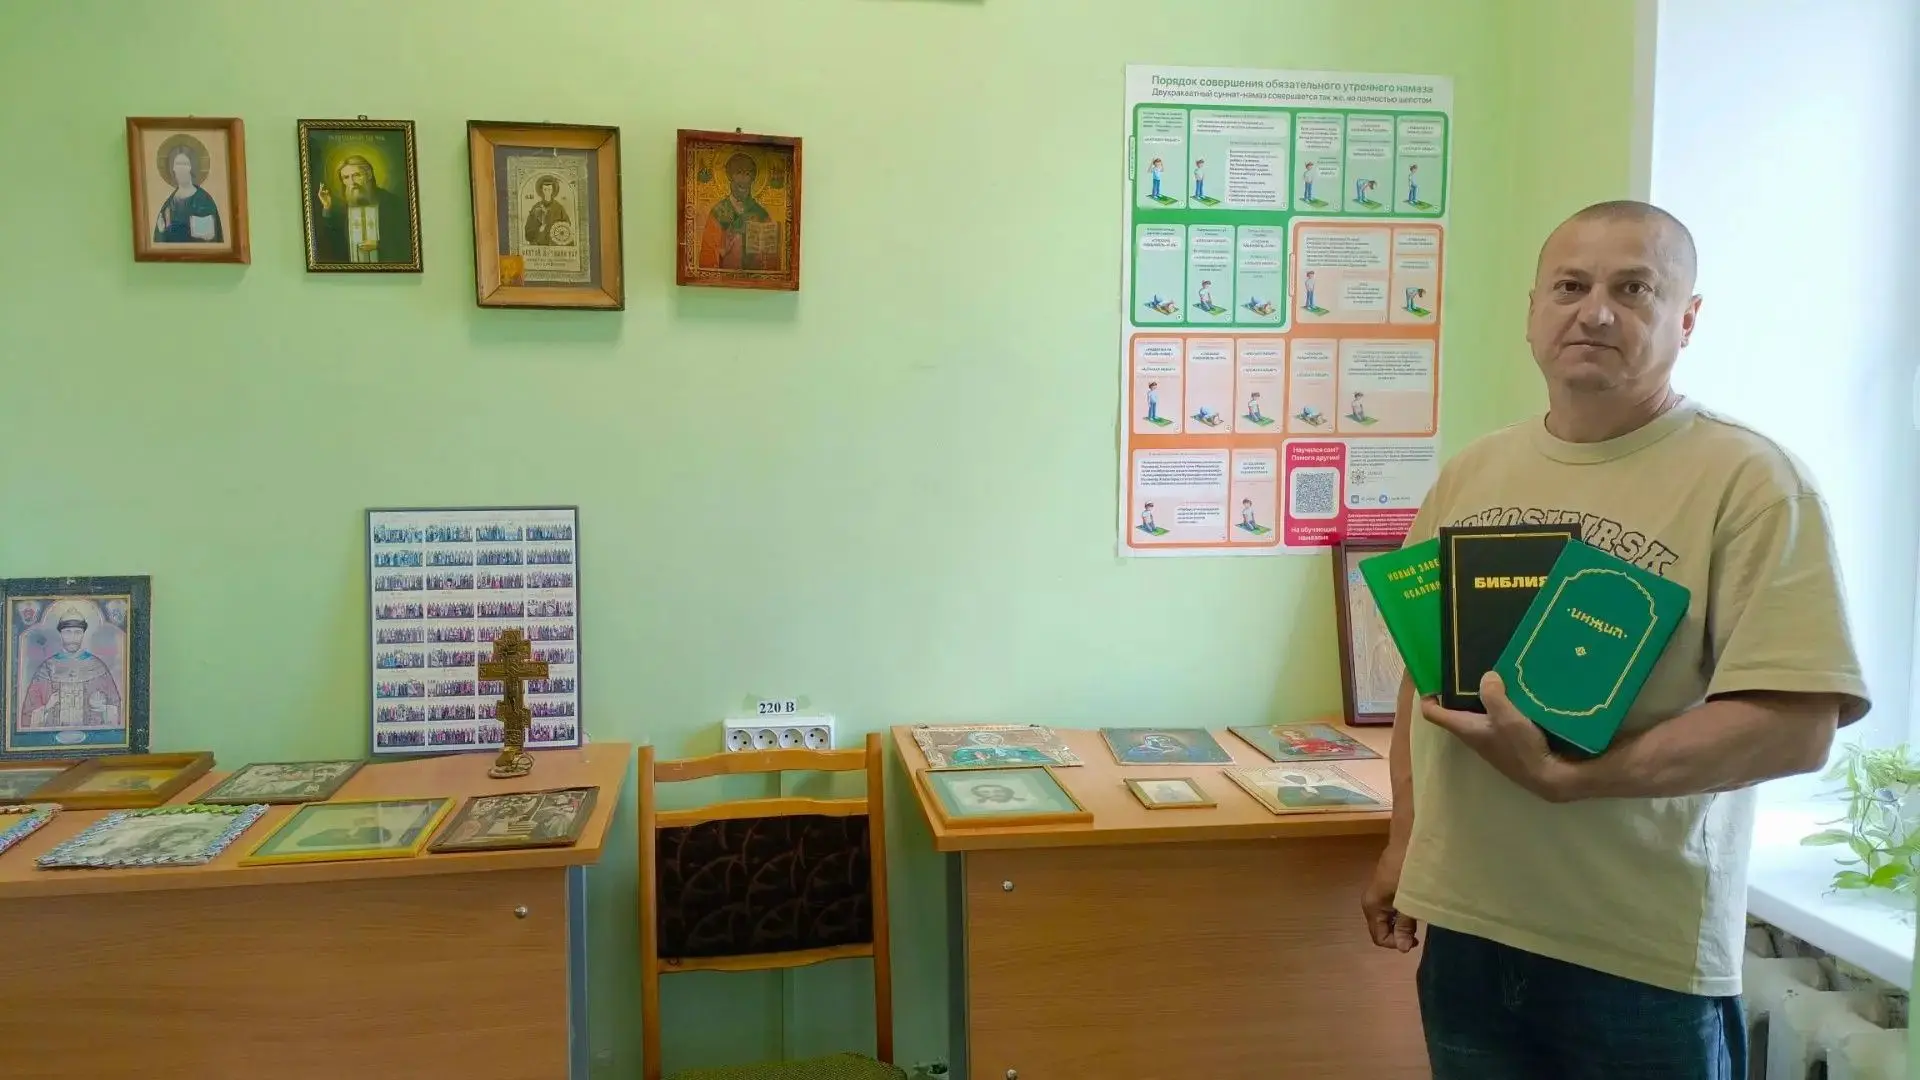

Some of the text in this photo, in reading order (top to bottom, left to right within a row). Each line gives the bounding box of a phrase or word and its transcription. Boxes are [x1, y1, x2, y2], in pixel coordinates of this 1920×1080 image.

[1152, 75, 1434, 94] Порядок совершения обязательного утреннего намаза
[1387, 558, 1440, 581] НОВЫЙ ЗАВЕ
[1403, 580, 1440, 599] ПСАЛТИР
[759, 702, 781, 714] 220
